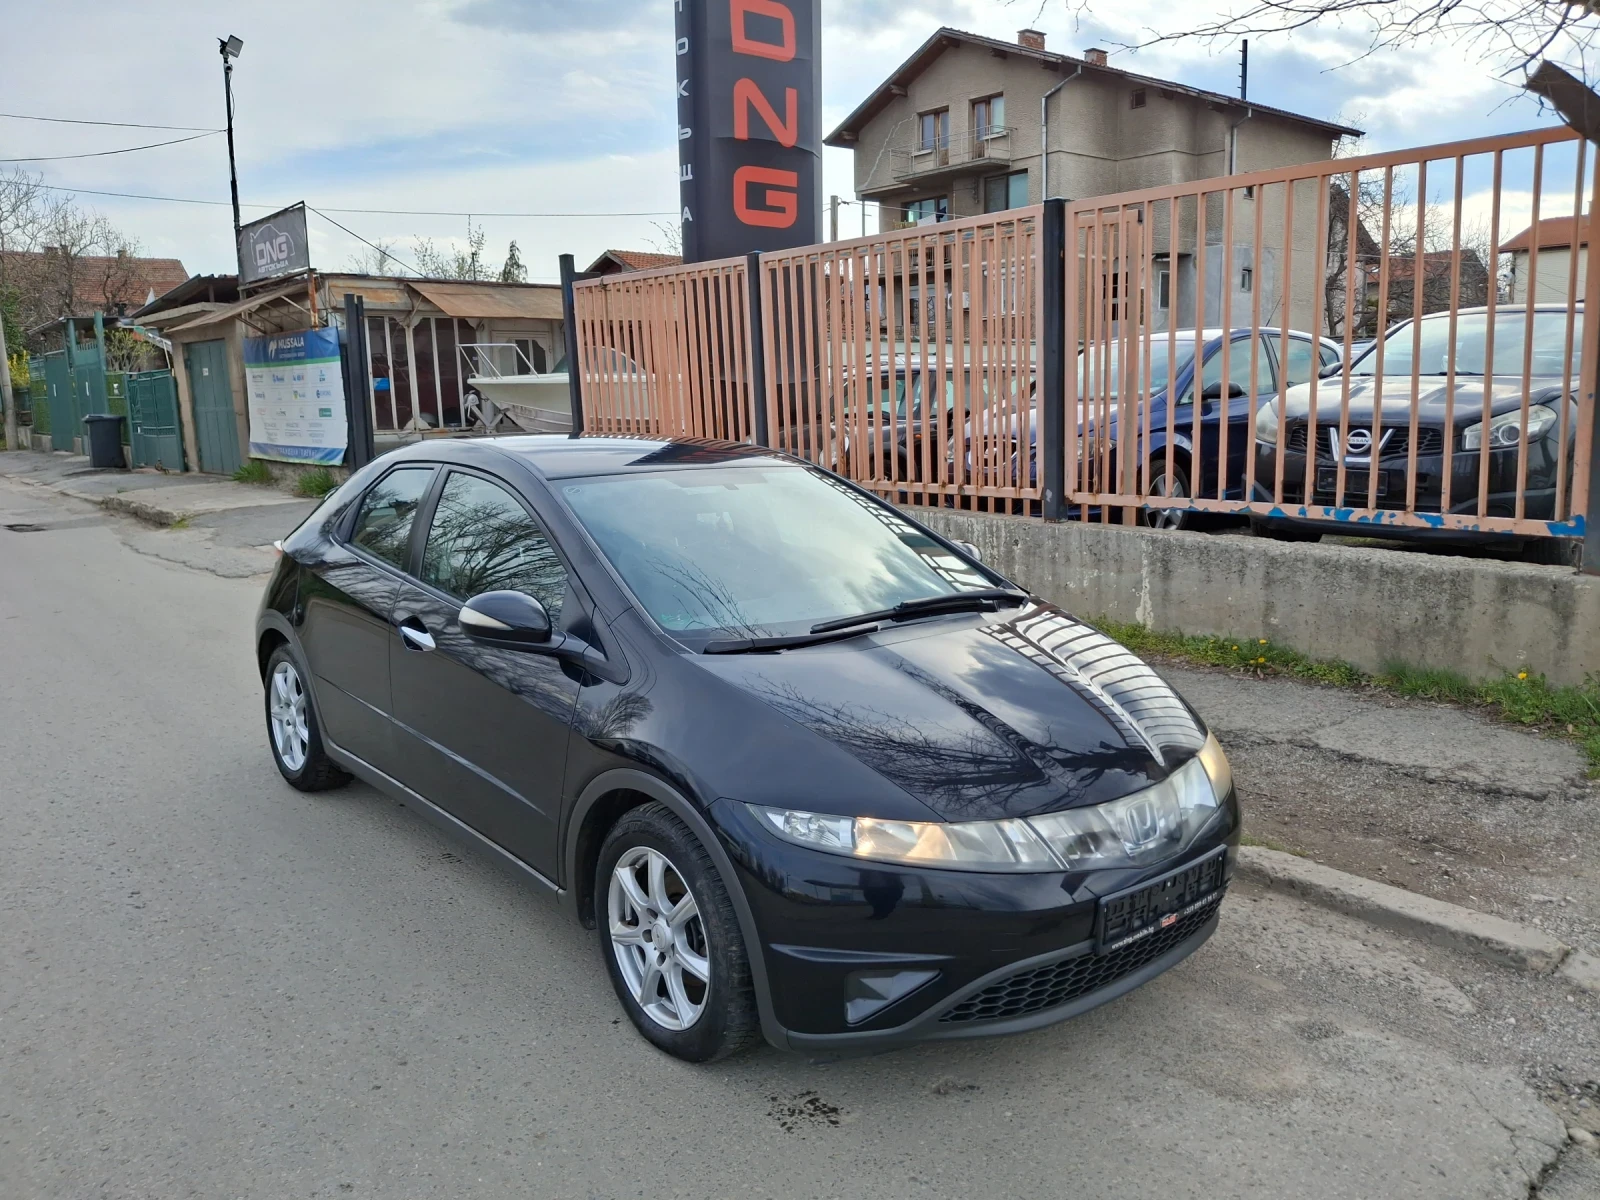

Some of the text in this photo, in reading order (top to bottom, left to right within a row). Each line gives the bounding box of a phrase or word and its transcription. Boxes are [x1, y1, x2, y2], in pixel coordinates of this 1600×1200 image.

[730, 0, 798, 229] DNG
[255, 235, 288, 267] DNG
[278, 336, 305, 349] MUSSALA
